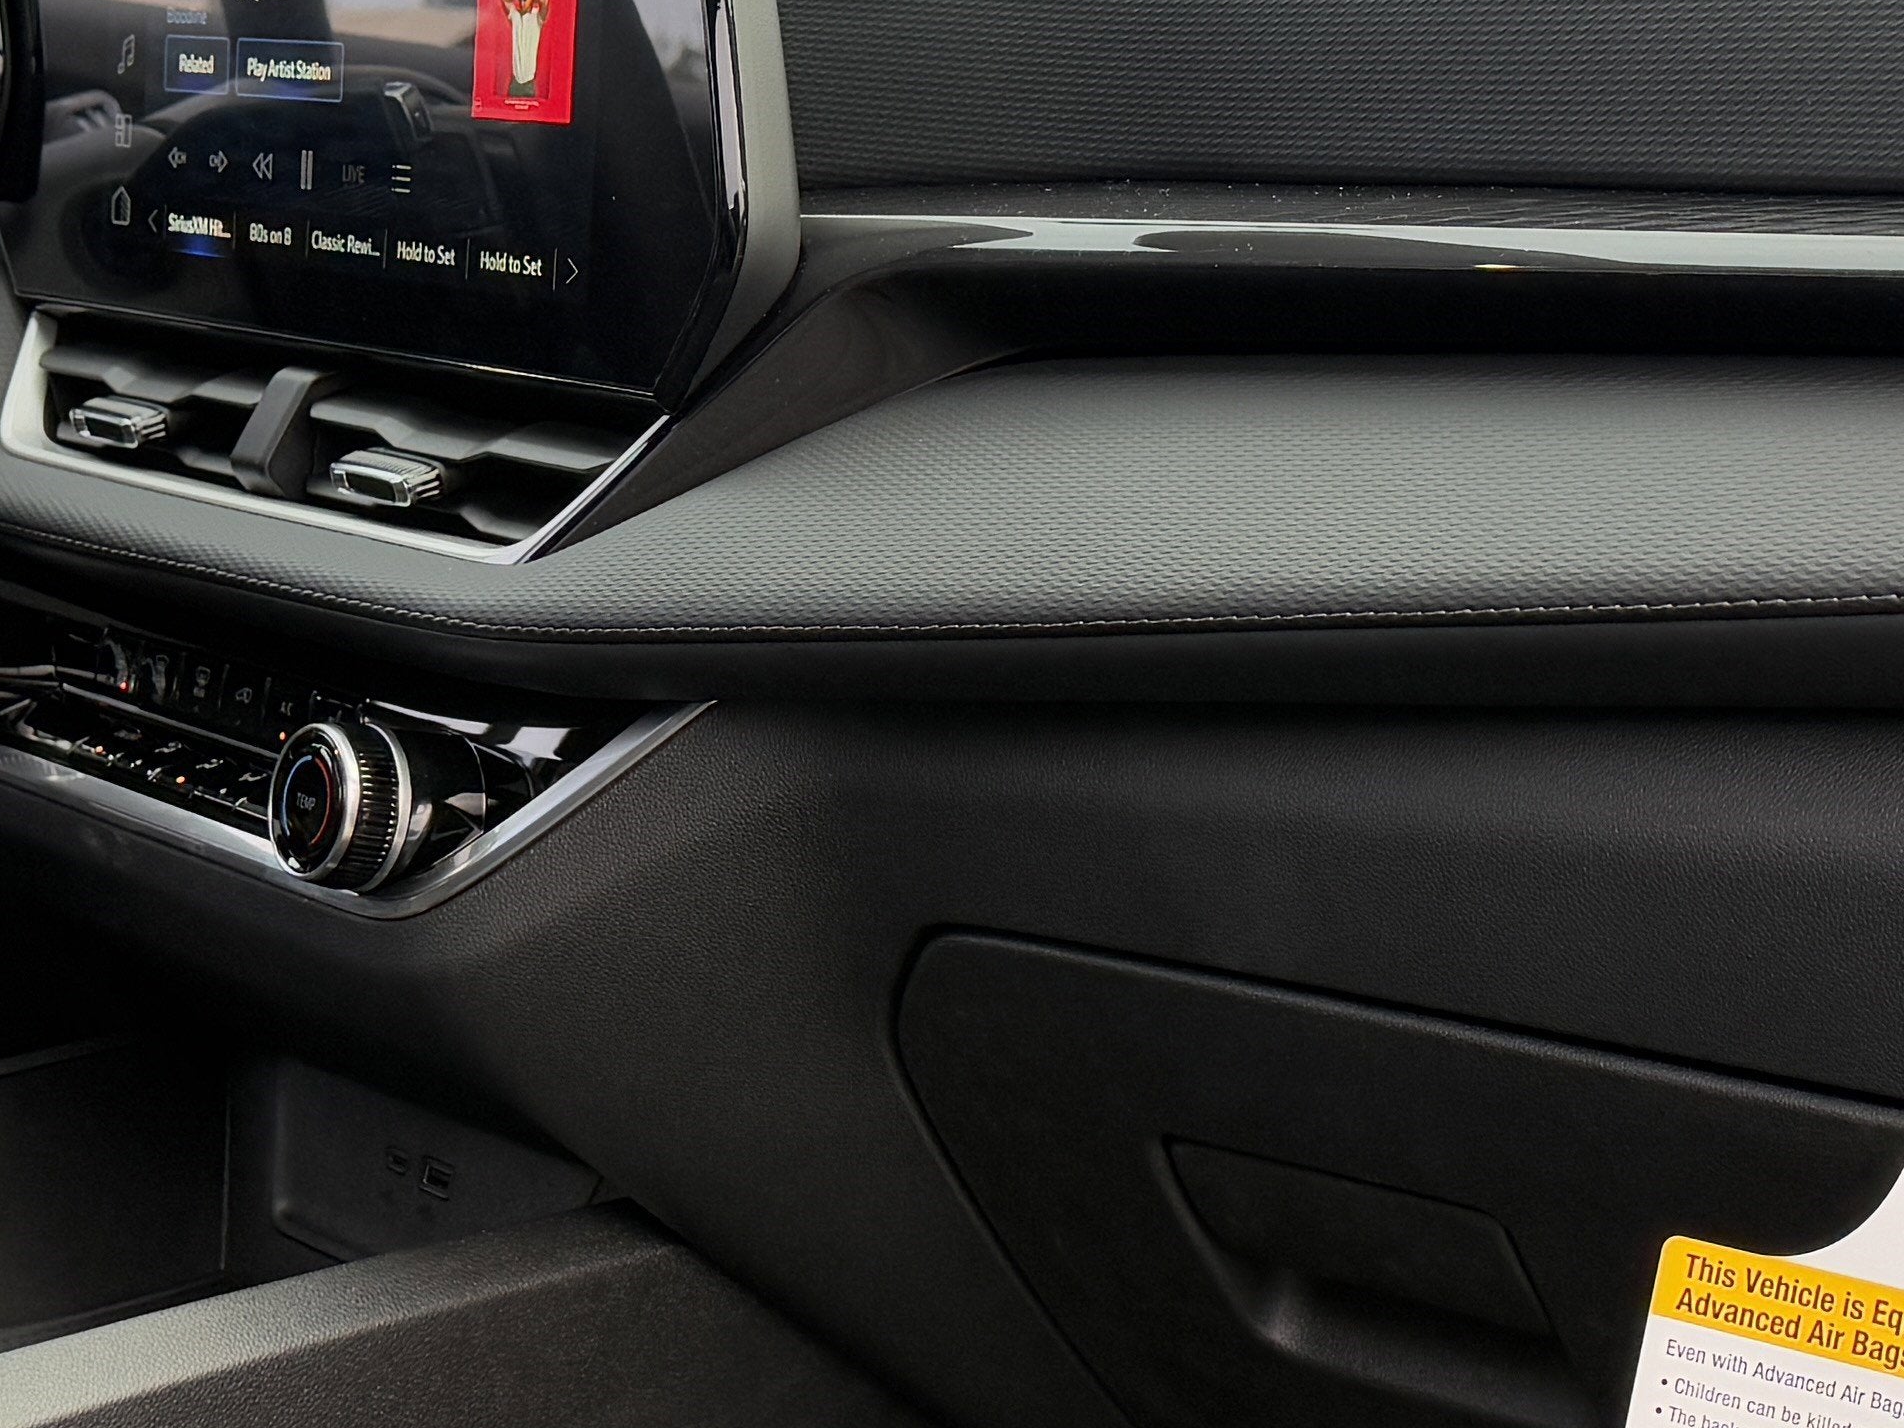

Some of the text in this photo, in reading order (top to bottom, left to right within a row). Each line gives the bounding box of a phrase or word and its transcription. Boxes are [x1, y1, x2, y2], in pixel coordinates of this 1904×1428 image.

[178, 53, 215, 75] Related
[247, 57, 332, 82] Play Artist Station
[342, 164, 366, 183] LIVE
[168, 212, 208, 235] SiriusXM
[249, 223, 292, 246] 80s on 8
[311, 229, 346, 252] Classic
[397, 240, 455, 266] Hold to Set
[480, 250, 543, 276] Hold to Set
[295, 791, 316, 810] TEMP
[1685, 1252, 1736, 1288] This
[1745, 1266, 1835, 1313] Vehicle
[1841, 1289, 1865, 1320] is
[1674, 1286, 1802, 1340] Advanced
[1805, 1318, 1846, 1350] Air
[1665, 1337, 1706, 1365] Even
[1711, 1352, 1748, 1375] with
[1750, 1360, 1837, 1398] Advanced
[1838, 1383, 1866, 1406] Air
[1673, 1376, 1741, 1410] Children
[1745, 1399, 1776, 1419] can
[1779, 1404, 1801, 1426] be
[1667, 1404, 1696, 1428] The
